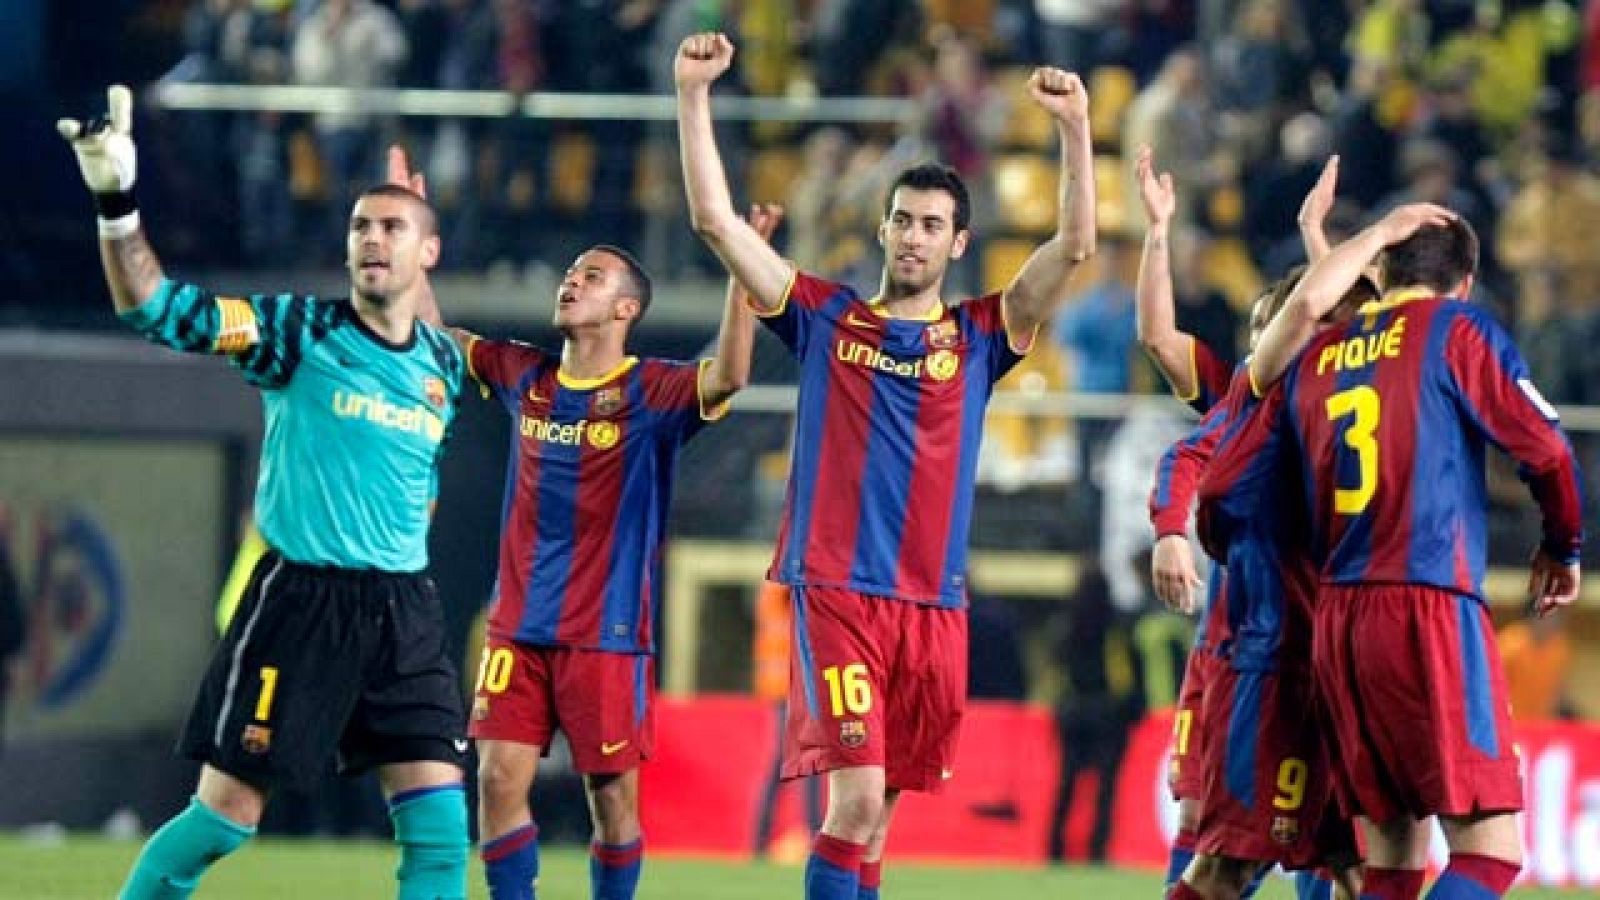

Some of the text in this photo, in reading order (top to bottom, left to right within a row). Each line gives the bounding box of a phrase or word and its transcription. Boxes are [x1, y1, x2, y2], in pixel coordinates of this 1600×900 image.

[837, 339, 922, 379] unicef
[1317, 317, 1406, 375] PIQUÉ
[333, 390, 424, 433] unicef
[520, 414, 588, 446] unicef
[1326, 385, 1380, 515] 3
[255, 666, 279, 720] 1
[823, 662, 872, 718] 16
[1272, 757, 1308, 811] 9
